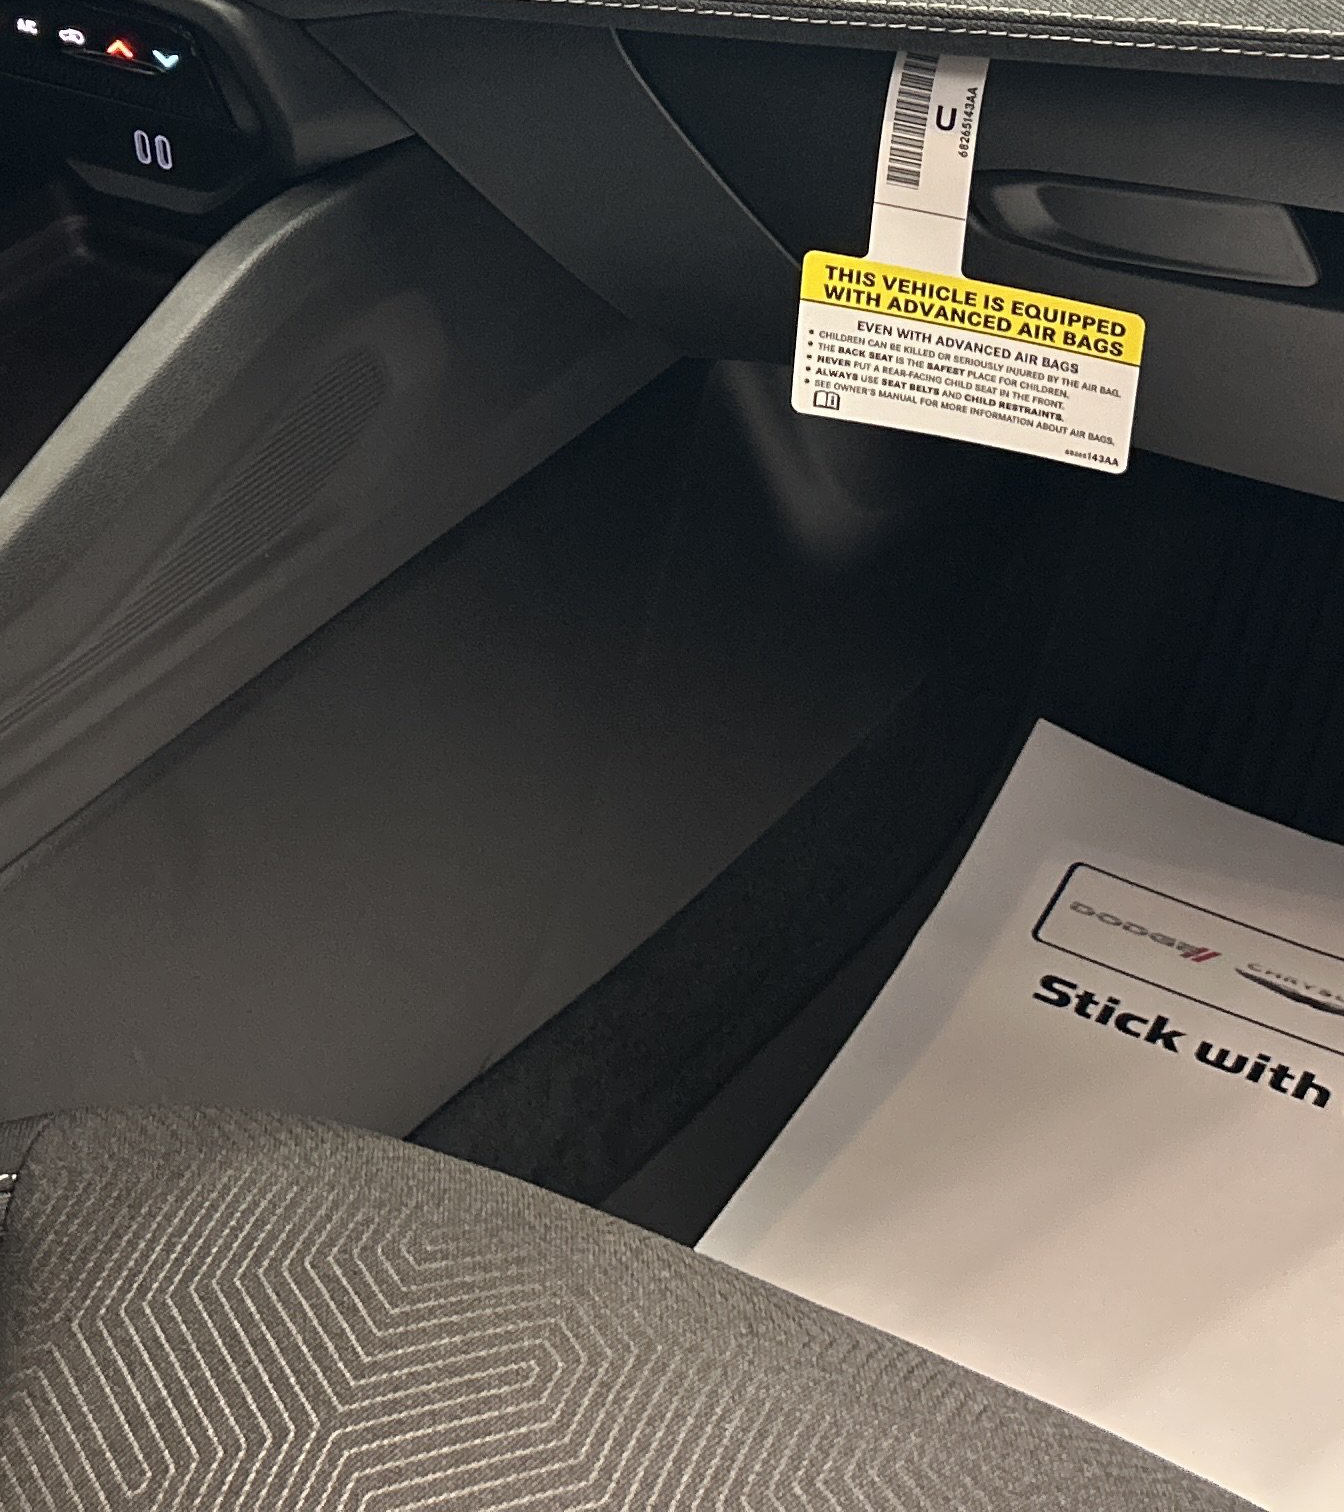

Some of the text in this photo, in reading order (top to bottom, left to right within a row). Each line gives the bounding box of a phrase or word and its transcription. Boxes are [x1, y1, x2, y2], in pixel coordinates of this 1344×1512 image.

[936, 105, 957, 131] U
[958, 87, 978, 158] 68265143AA
[824, 284, 1124, 357] WITH ADVANCED AIR BAGS
[825, 264, 1126, 337] THIS VEHICLE IS EQUIPPED
[818, 342, 1069, 399] THE BACK SEAT IS THE SAFEST PLACE FOR CHILDREN.
[819, 330, 865, 345] CHILDREN
[868, 339, 887, 349] CAN
[890, 343, 901, 352] BE
[904, 346, 935, 358] KILLED
[938, 352, 951, 361] OR
[954, 356, 1004, 373] SERIOUSLY
[1006, 366, 1045, 381] INJURED
[1047, 375, 1058, 383] BY
[1062, 378, 1079, 388] THE
[1081, 382, 1097, 392] AIR
[857, 320, 1079, 374] EVEN WITH ADVANCED AIR BAGS
[815, 380, 831, 389] SEE
[834, 382, 876, 397] OWNER'S
[879, 391, 917, 404] MANUAL
[920, 398, 938, 408] FOR
[941, 401, 967, 414] MORE
[970, 407, 1034, 428] INFORMATION
[1036, 421, 1068, 435] ABOUT
[1070, 429, 1086, 439] AIR
[816, 368, 1064, 422] ALWAYS USE SEAT BELTS AND CHILD RESTRAINTS.
[817, 355, 851, 367] NEVER
[854, 361, 871, 370] PUT
[883, 367, 942, 384] REAR-FACING
[945, 378, 972, 389] CHILD
[975, 384, 998, 395] SEAT
[1000, 388, 1009, 398] IN
[1013, 392, 1030, 402] THE
[1032, 396, 1064, 410] FRONT.
[1032, 974, 1187, 1053] Stick
[1194, 1040, 1332, 1109] with
